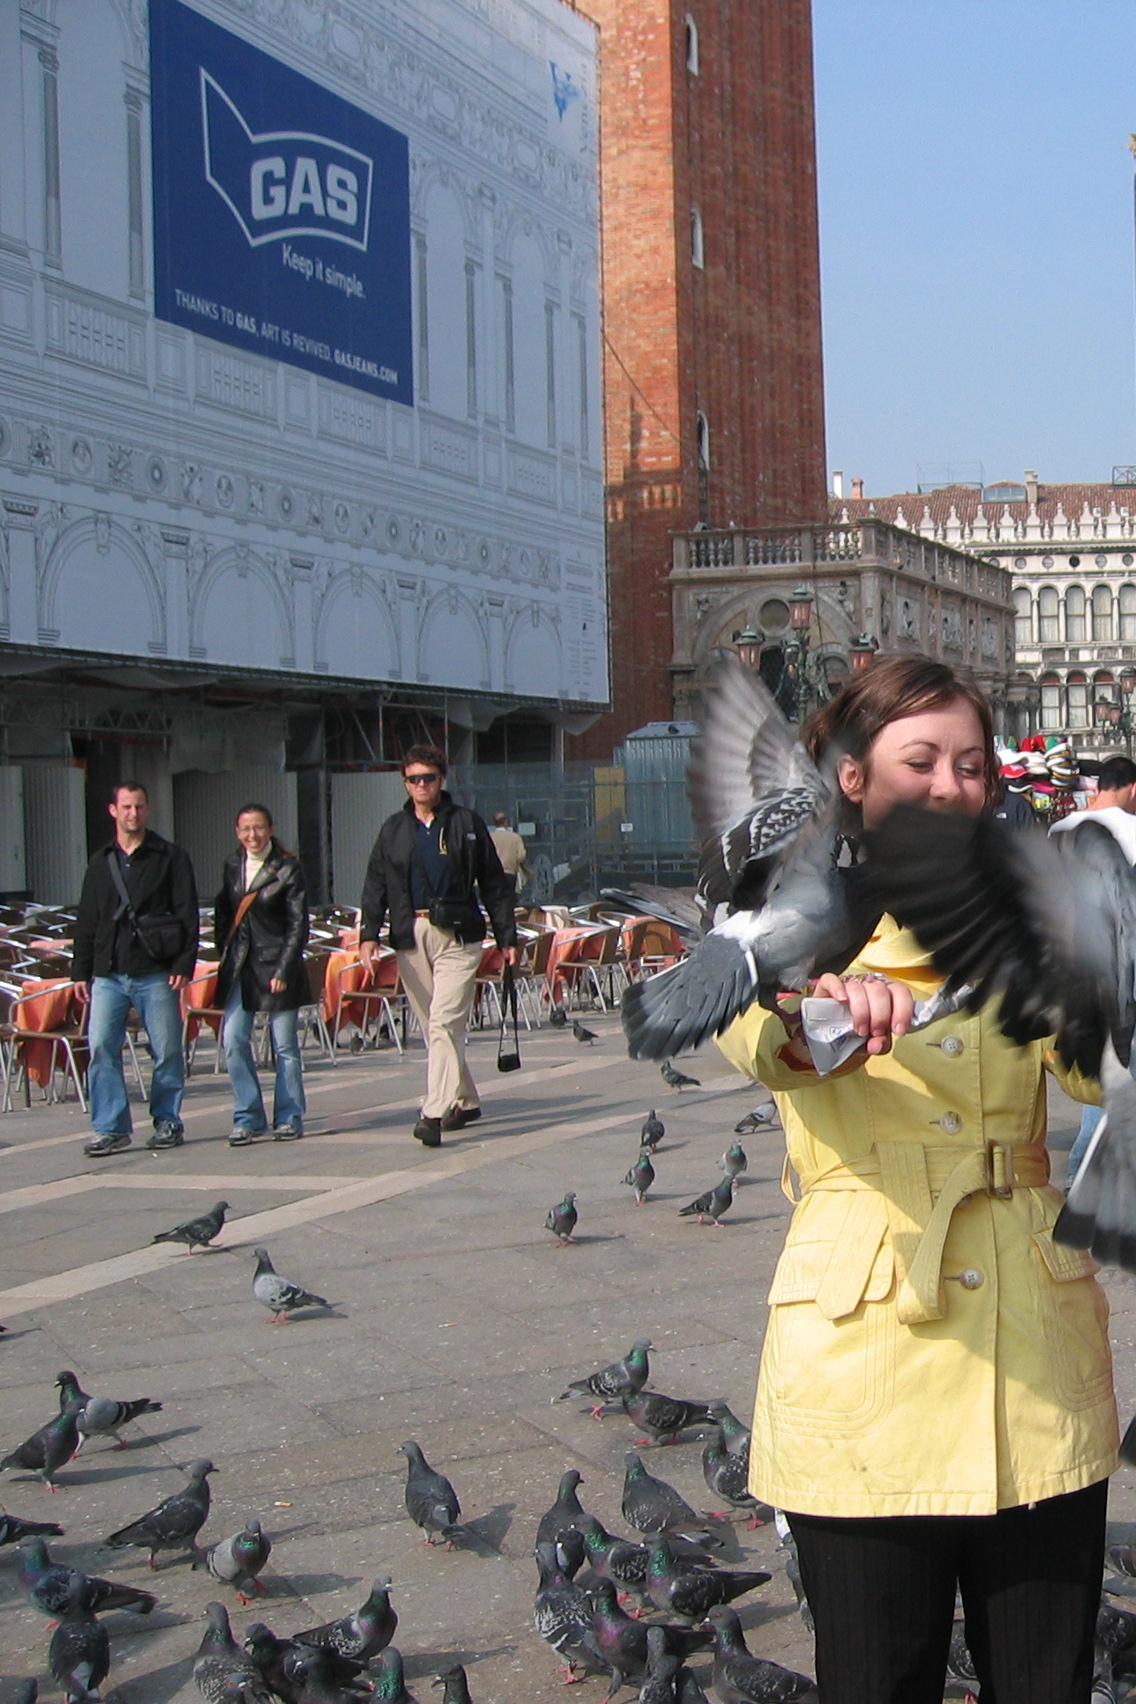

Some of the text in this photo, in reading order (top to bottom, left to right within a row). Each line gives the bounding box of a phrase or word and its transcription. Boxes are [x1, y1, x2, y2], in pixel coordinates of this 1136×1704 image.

[250, 156, 358, 226] GAS
[282, 243, 366, 299] Keep it simple.
[175, 287, 398, 385] THANKS TO GAS, ART IS REVIVED. GASJEANS.COM
